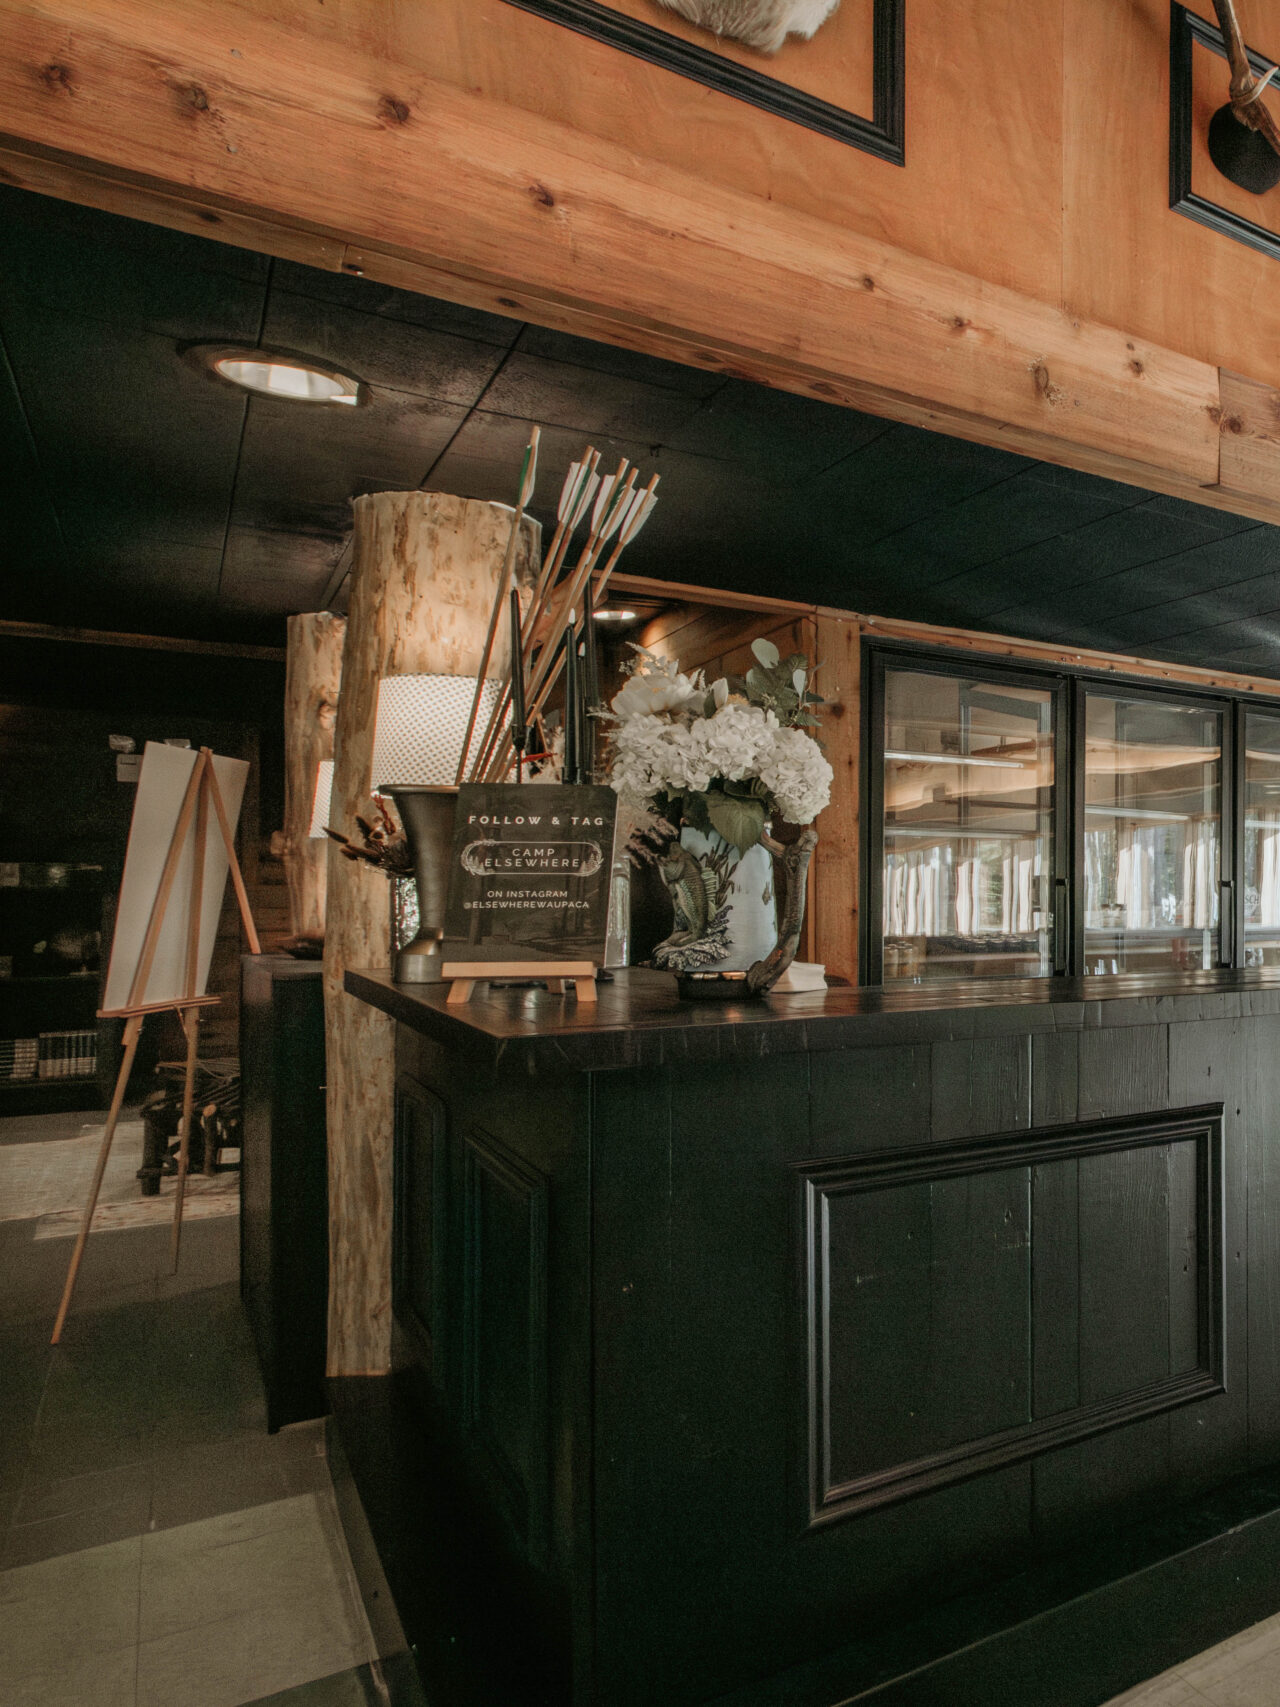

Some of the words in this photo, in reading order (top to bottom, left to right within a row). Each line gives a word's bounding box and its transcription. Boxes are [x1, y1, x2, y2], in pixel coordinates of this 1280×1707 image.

[468, 815, 542, 825] FOLLOW
[551, 816, 561, 825] &
[571, 816, 605, 826] TAG
[512, 848, 556, 857] CAMP
[484, 858, 581, 867] ELSEWHERE
[487, 890, 503, 899] ON
[506, 890, 569, 899] INSTAGRAM
[463, 900, 590, 910] @ELSEWHEREWAUPACA
